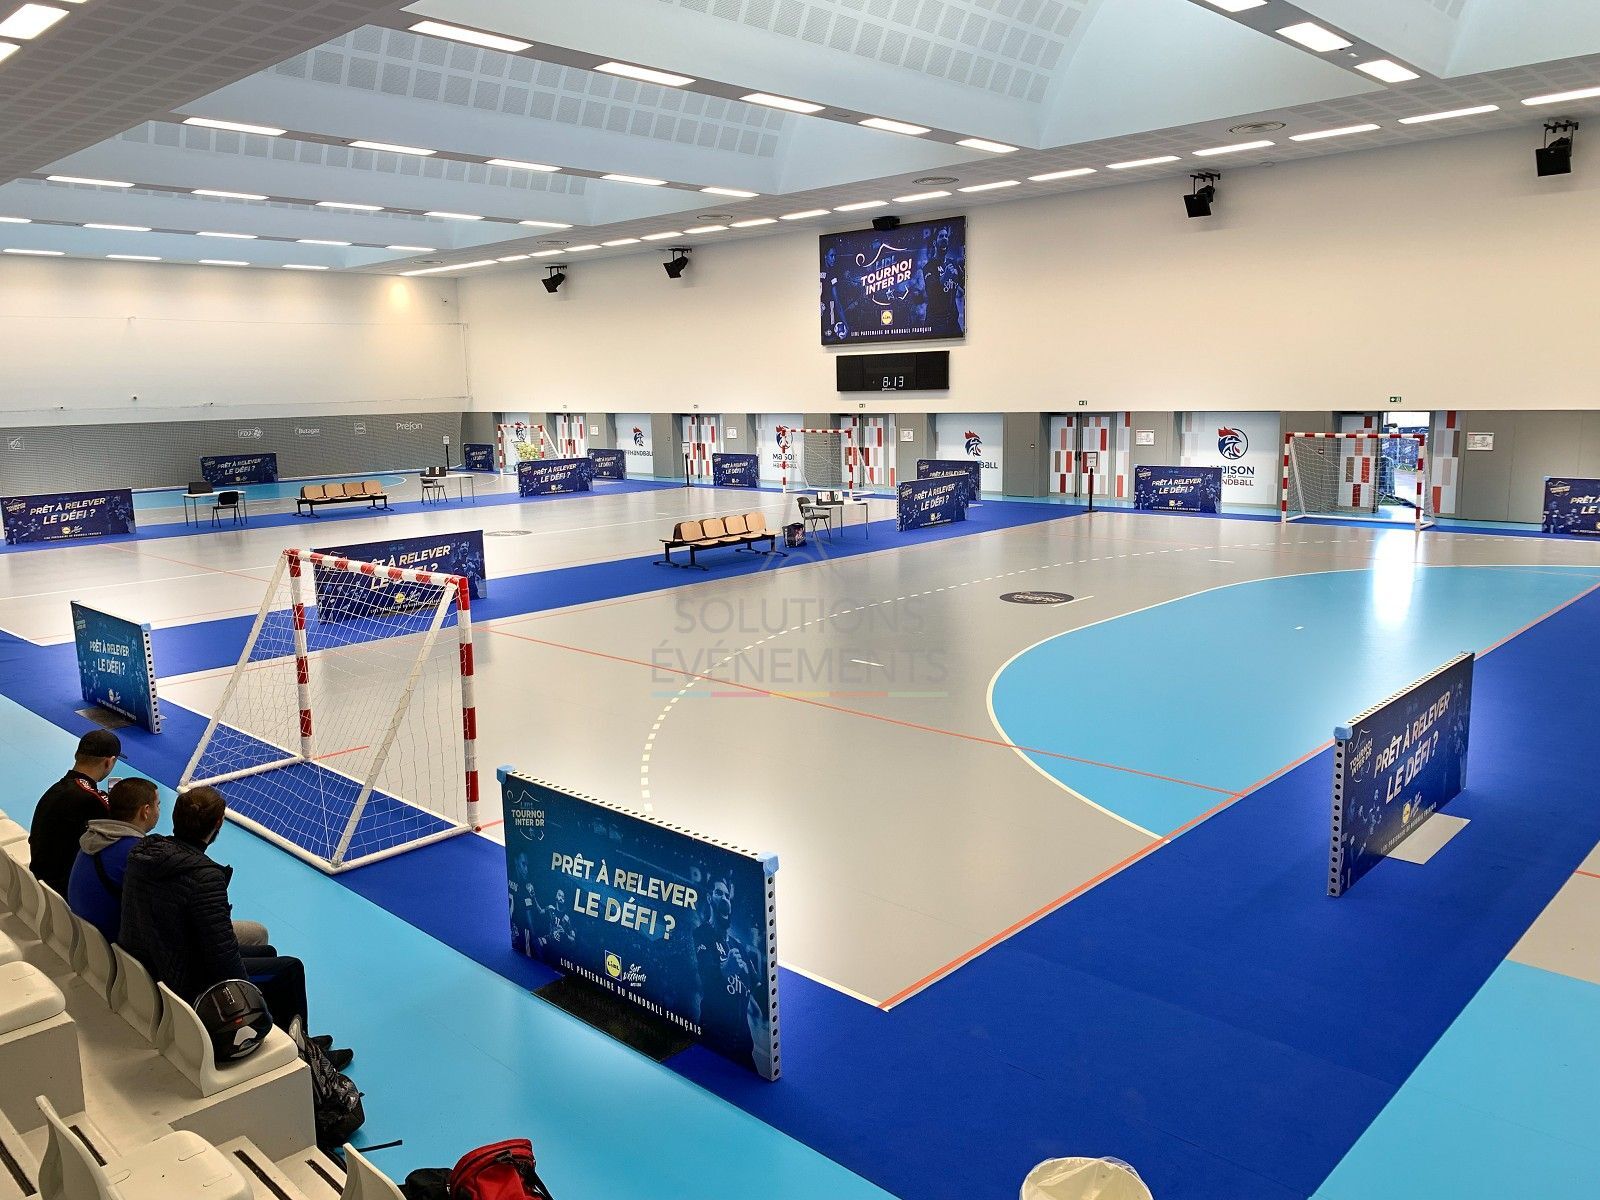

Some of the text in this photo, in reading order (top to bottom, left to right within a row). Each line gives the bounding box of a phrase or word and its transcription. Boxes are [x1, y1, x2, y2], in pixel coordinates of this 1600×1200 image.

[861, 258, 912, 287] TOURNOI
[866, 270, 911, 295] INTER DR
[1170, 485, 1188, 494] DÉFI
[1570, 495, 1596, 504] PRÊT
[30, 504, 54, 515] PRÊT
[55, 502, 63, 511] À
[64, 498, 106, 510] RELEVER
[920, 495, 949, 511] LE DÉFI ?
[1581, 506, 1597, 514] LE
[43, 508, 96, 525] LE DÉFI ?
[399, 545, 451, 566] RELEVER
[97, 657, 126, 676] LE DÉFI ?
[1374, 690, 1450, 778] PRÊT À RELEVER
[1386, 764, 1405, 804] LE
[1404, 740, 1432, 786] DÉFI
[1432, 730, 1438, 757] ?
[512, 810, 544, 818] TOURNOI
[551, 852, 698, 910] PRÊT À RELEVER
[573, 888, 676, 940] LE DÉFI ?
[560, 957, 574, 971] LIDL
[576, 965, 615, 992] PARTENAIRE
[617, 986, 626, 996] DU
[628, 991, 663, 1016] HANDBALL
[666, 1010, 702, 1036] FRANÇAIS
